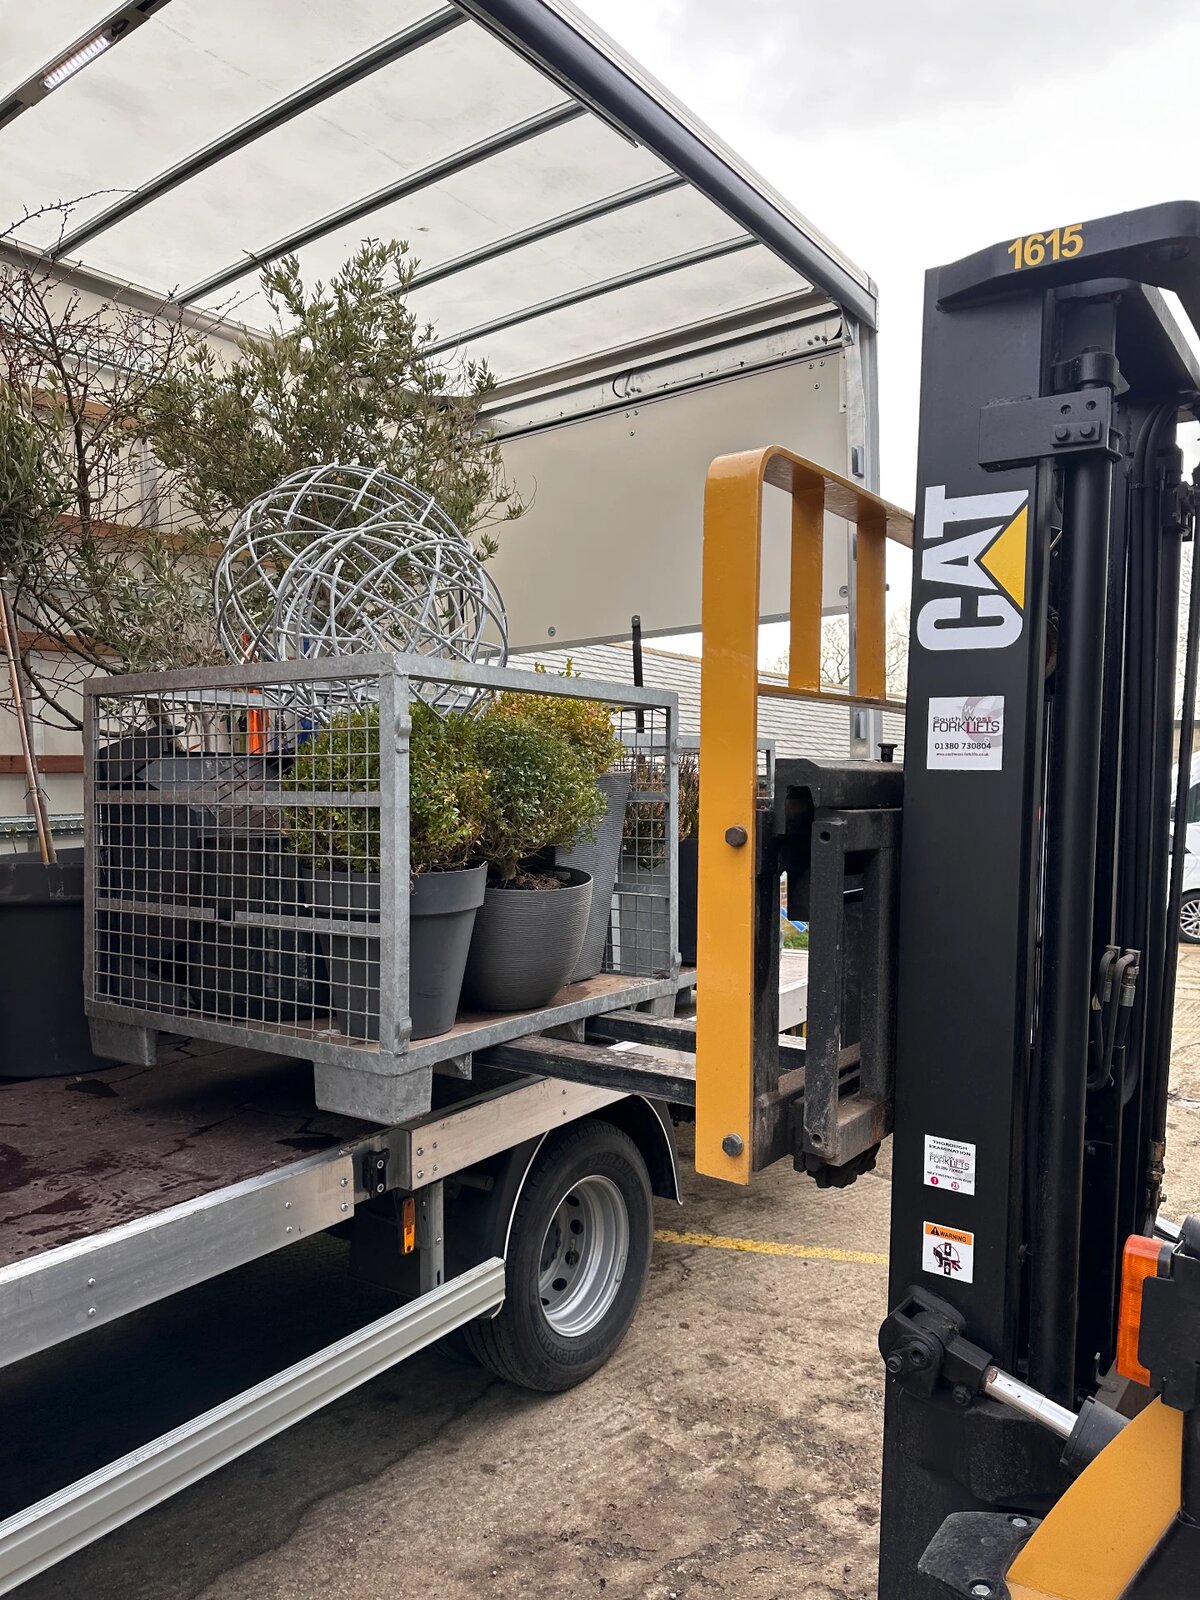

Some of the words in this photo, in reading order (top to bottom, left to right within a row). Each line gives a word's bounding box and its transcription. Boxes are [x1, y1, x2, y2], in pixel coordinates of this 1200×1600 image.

[1007, 223, 1084, 270] 1615
[917, 485, 1029, 651] CAT
[964, 715, 992, 723] West
[933, 721, 1000, 733] FORKLIFTS
[929, 1144, 971, 1157] EXAMINATION
[932, 1140, 968, 1151] THOROUGH
[929, 1154, 970, 1171] FORKLIFTS
[940, 1230, 967, 1243] WARNING
